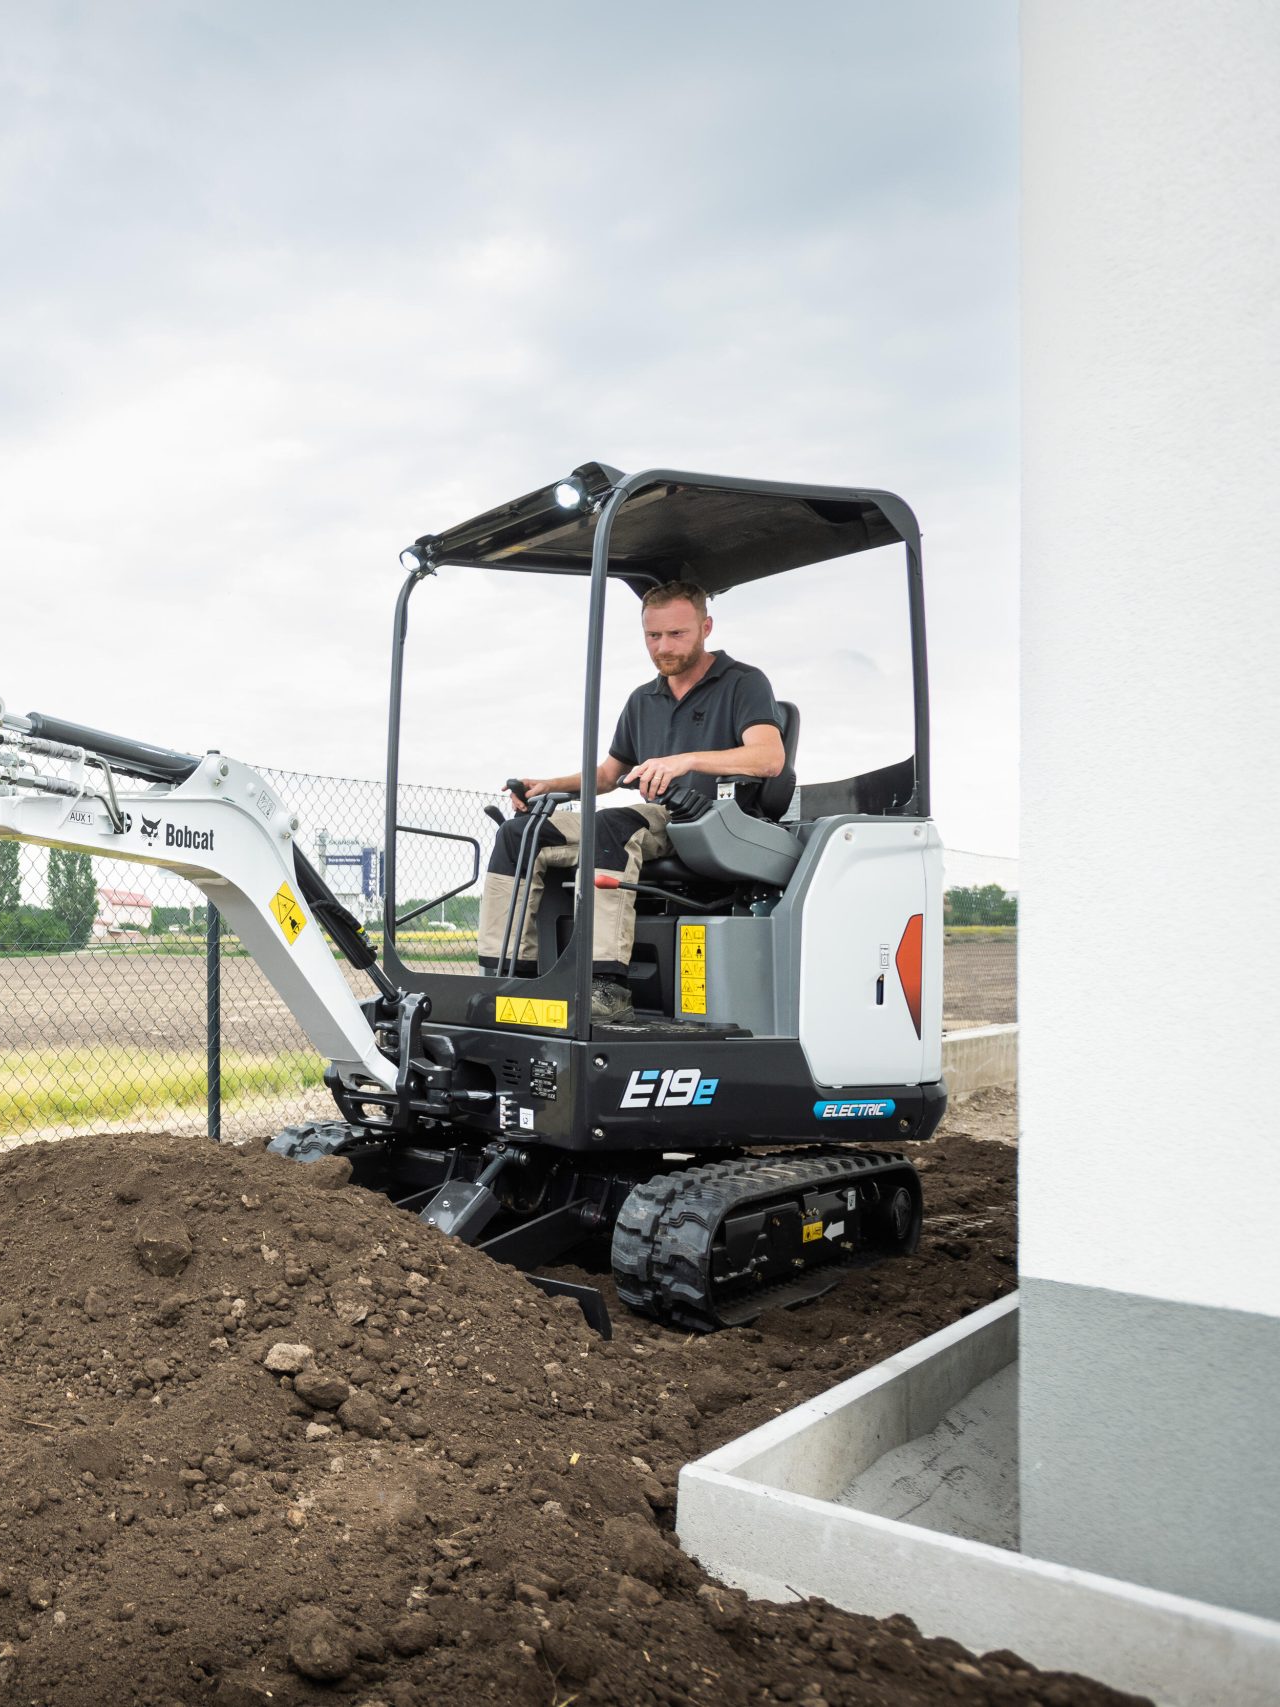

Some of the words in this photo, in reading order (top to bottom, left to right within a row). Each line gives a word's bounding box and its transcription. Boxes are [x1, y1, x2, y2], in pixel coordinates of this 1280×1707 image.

[70, 812, 86, 823] AUX
[87, 814, 91, 823] 1
[165, 823, 215, 851] Bobcat
[620, 1068, 720, 1109] E19e
[822, 1103, 887, 1118] ELECTRIC
